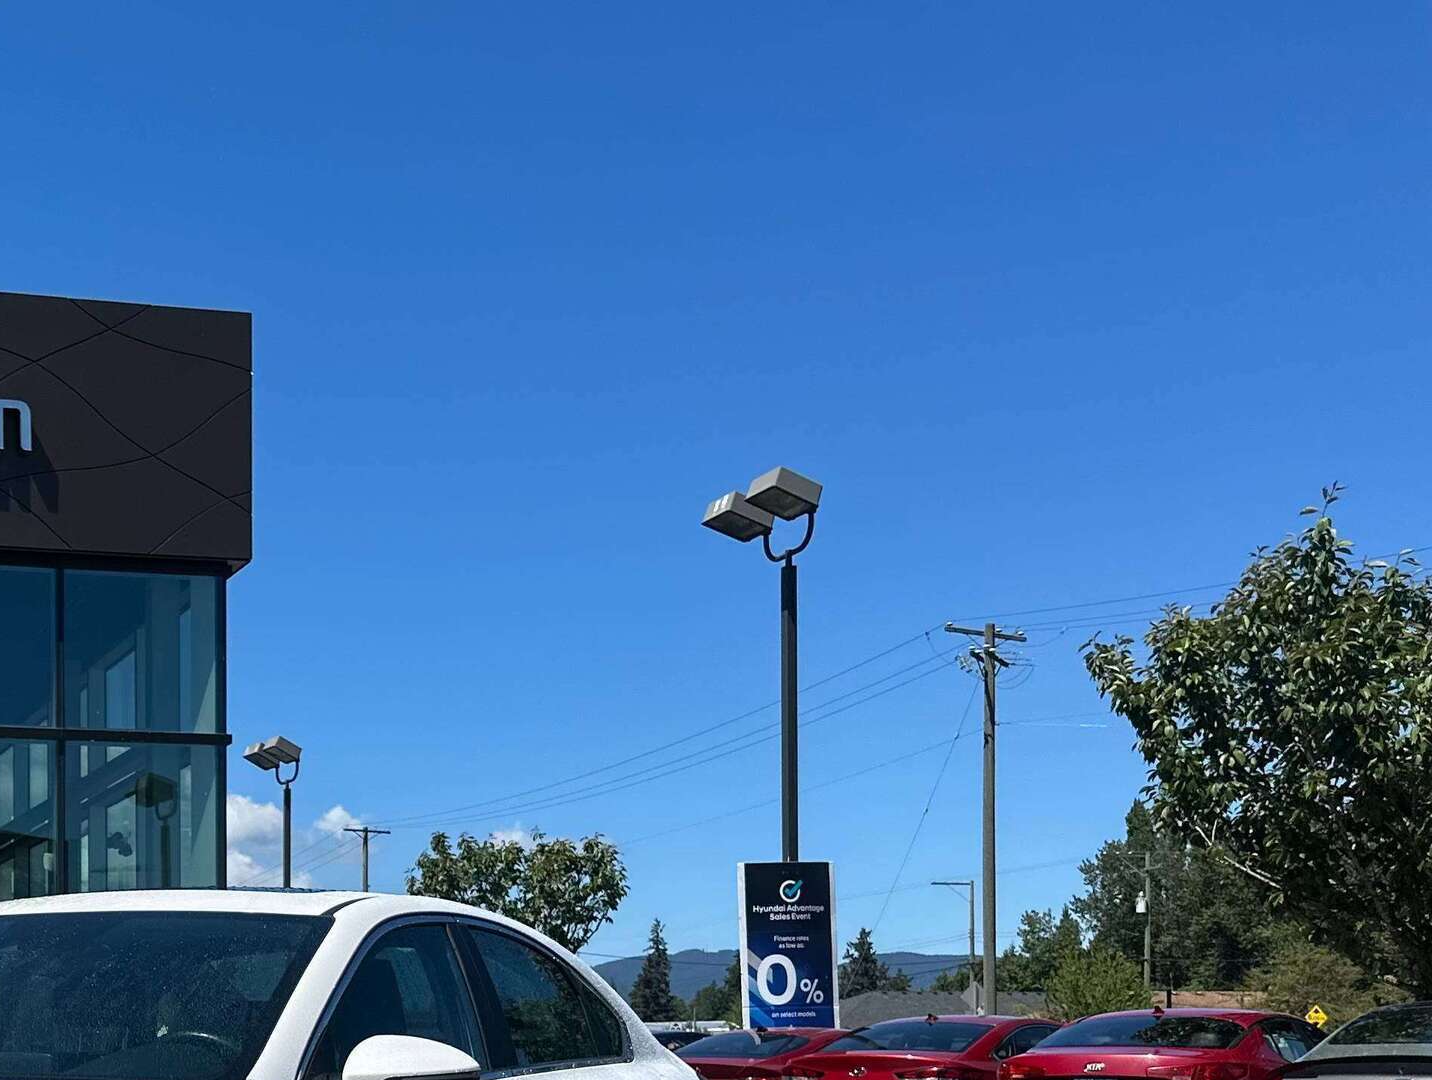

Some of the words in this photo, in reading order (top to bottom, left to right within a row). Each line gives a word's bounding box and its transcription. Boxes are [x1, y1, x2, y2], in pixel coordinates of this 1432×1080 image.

[752, 904, 786, 914] Hyundai
[786, 904, 825, 914] Advantage
[769, 912, 791, 921] Sales
[791, 912, 811, 920] Event
[757, 954, 824, 1006] 0%
